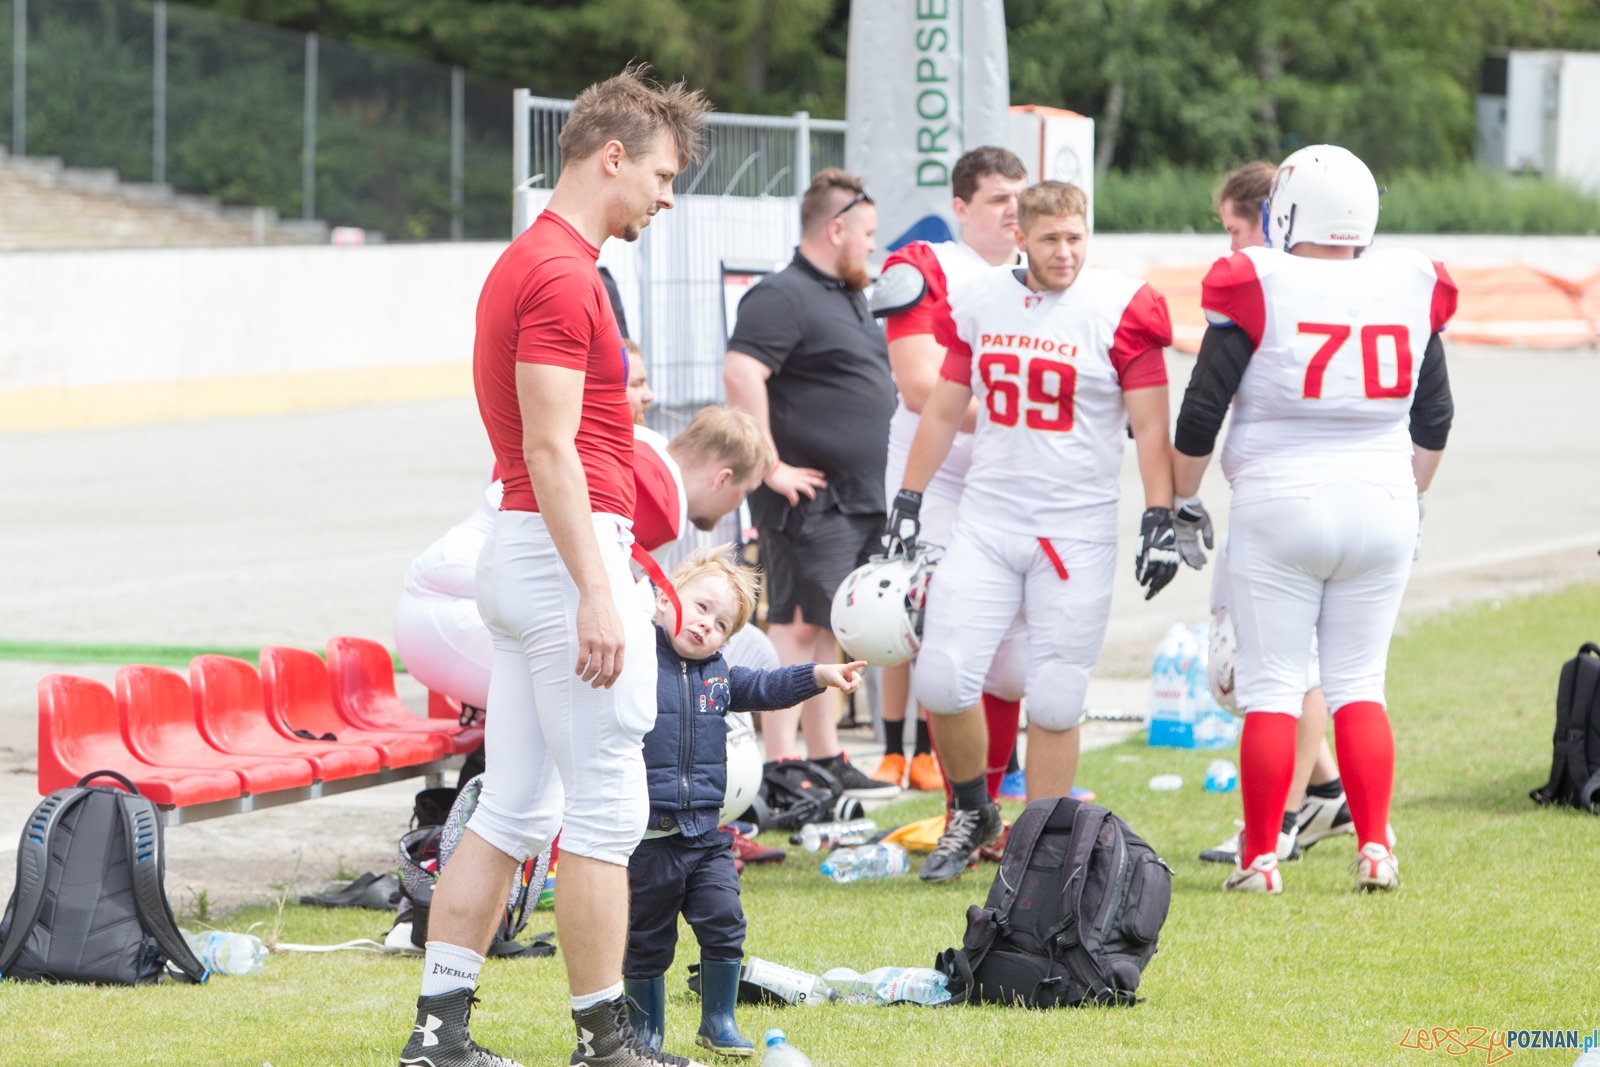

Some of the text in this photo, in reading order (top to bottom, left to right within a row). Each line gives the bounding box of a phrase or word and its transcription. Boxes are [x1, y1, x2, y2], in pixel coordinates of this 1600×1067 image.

[916, 0, 950, 187] DROPSE
[981, 334, 1078, 358] PATRIOCI
[1296, 321, 1413, 400] 70
[978, 352, 1077, 433] 69
